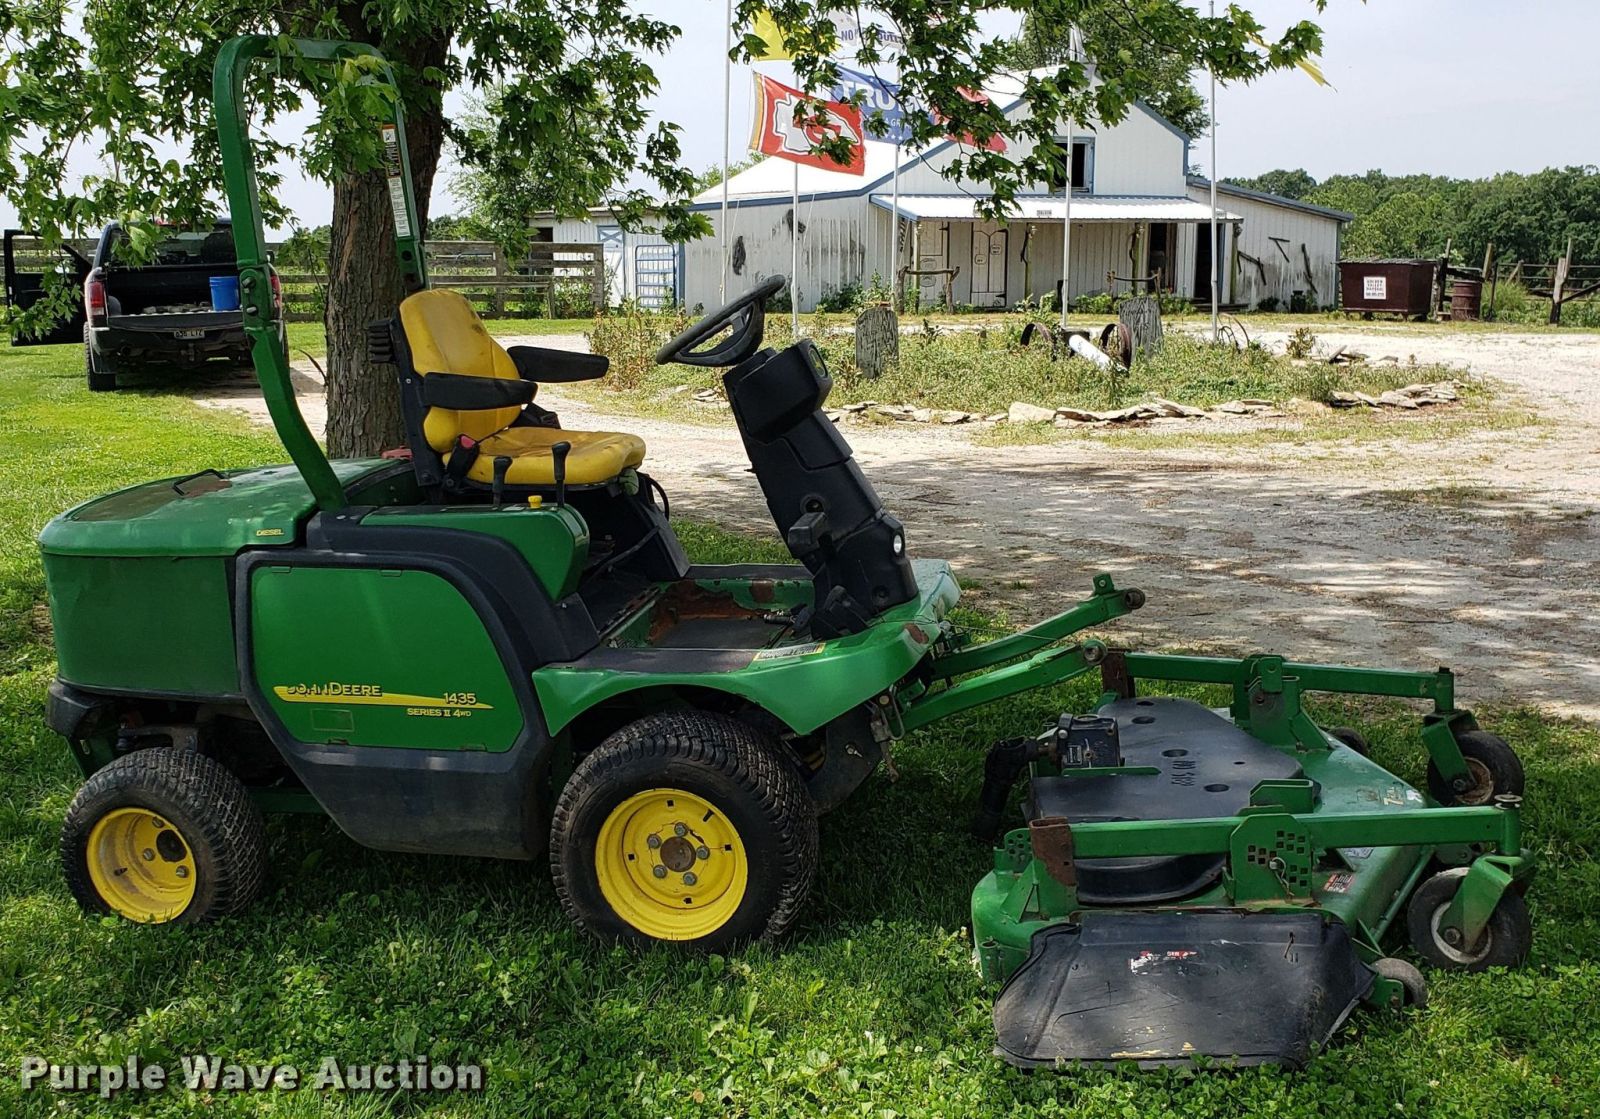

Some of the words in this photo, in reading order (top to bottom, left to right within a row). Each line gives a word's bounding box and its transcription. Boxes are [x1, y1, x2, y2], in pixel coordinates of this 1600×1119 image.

[329, 682, 382, 696] DEERE
[443, 692, 476, 704] 1435
[407, 708, 442, 717] SERIES
[453, 709, 472, 718] 4WD
